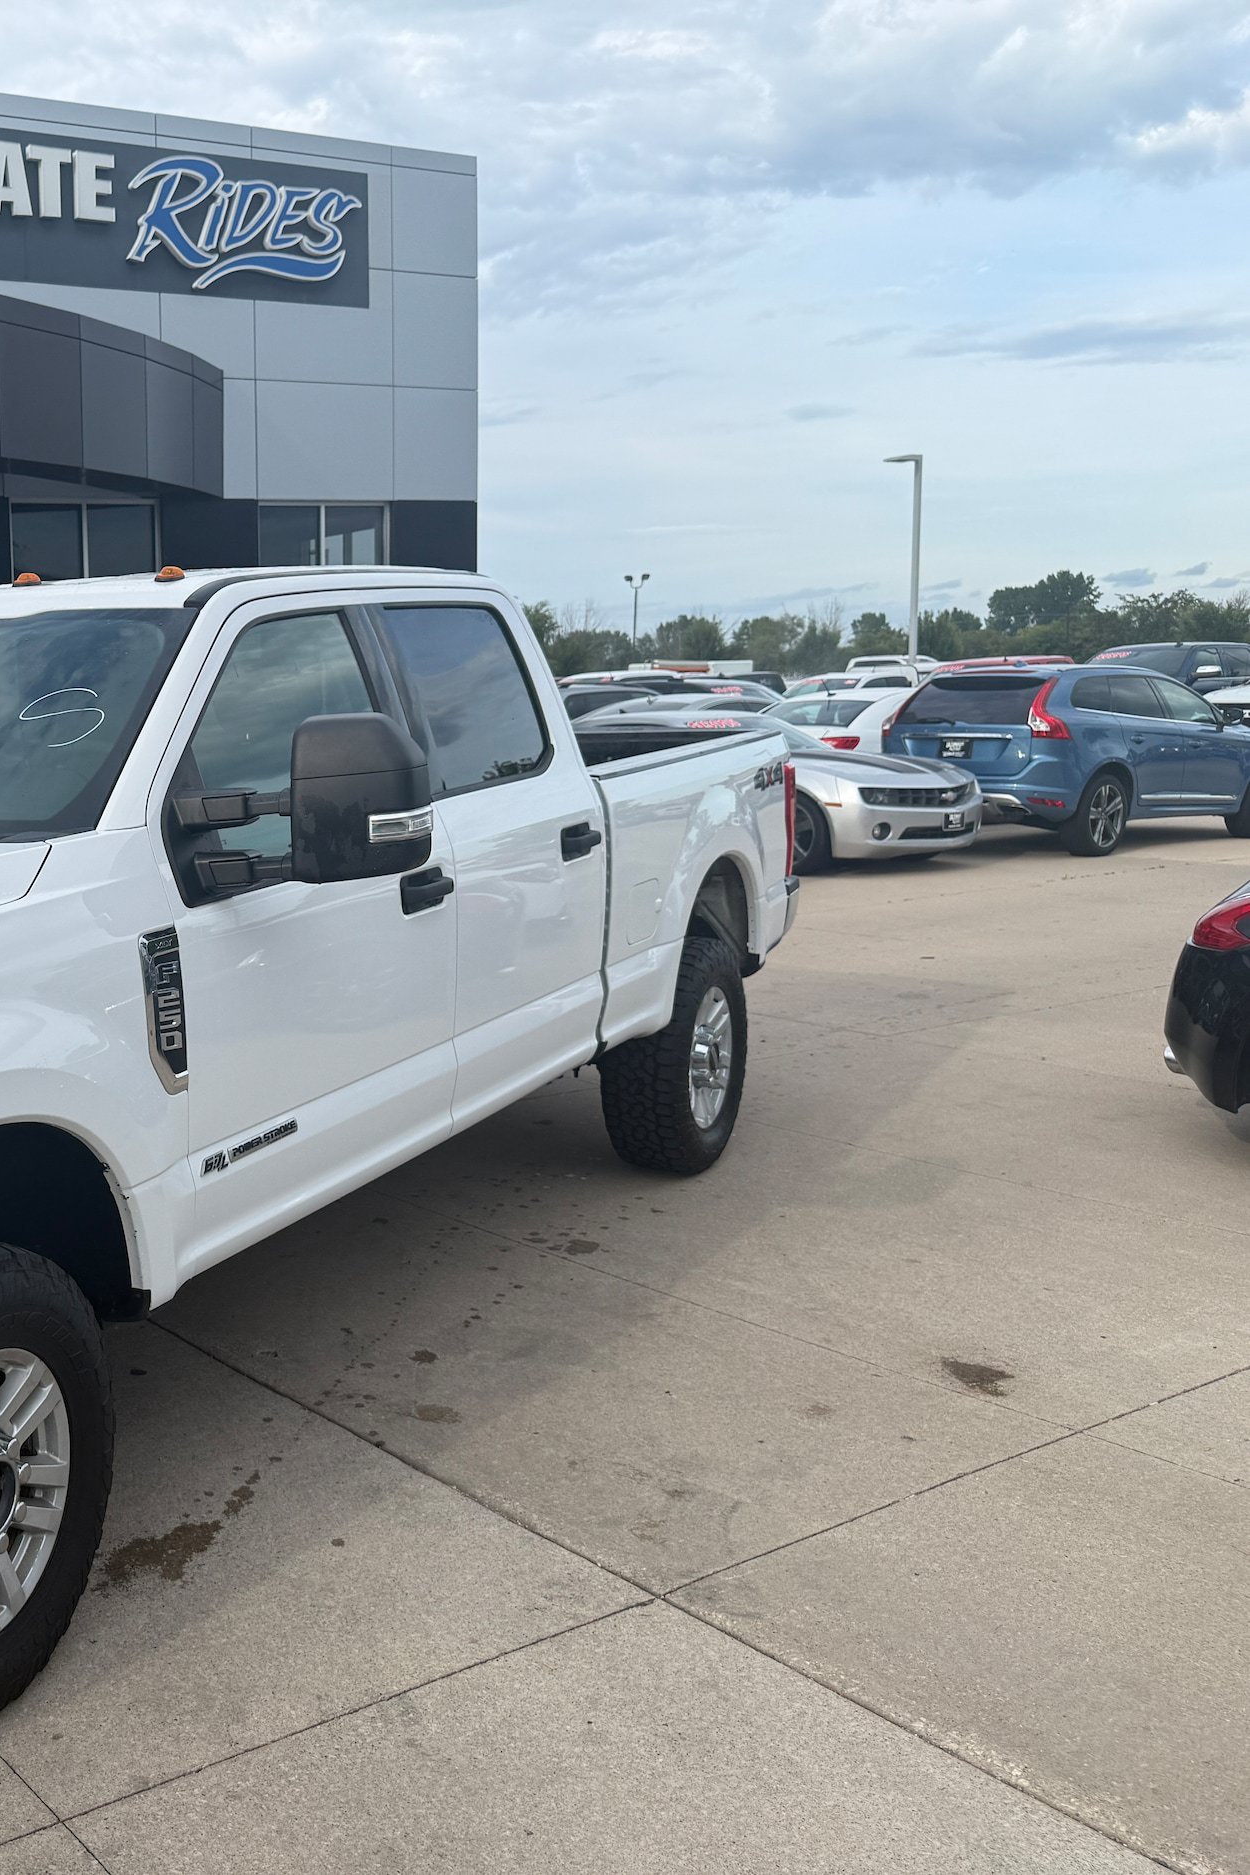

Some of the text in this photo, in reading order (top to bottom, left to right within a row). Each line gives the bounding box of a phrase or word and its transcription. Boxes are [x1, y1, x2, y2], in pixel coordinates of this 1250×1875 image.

[754, 761, 784, 792] 4X4
[232, 1136, 263, 1157] POWER
[263, 1120, 297, 1143] STROKE
